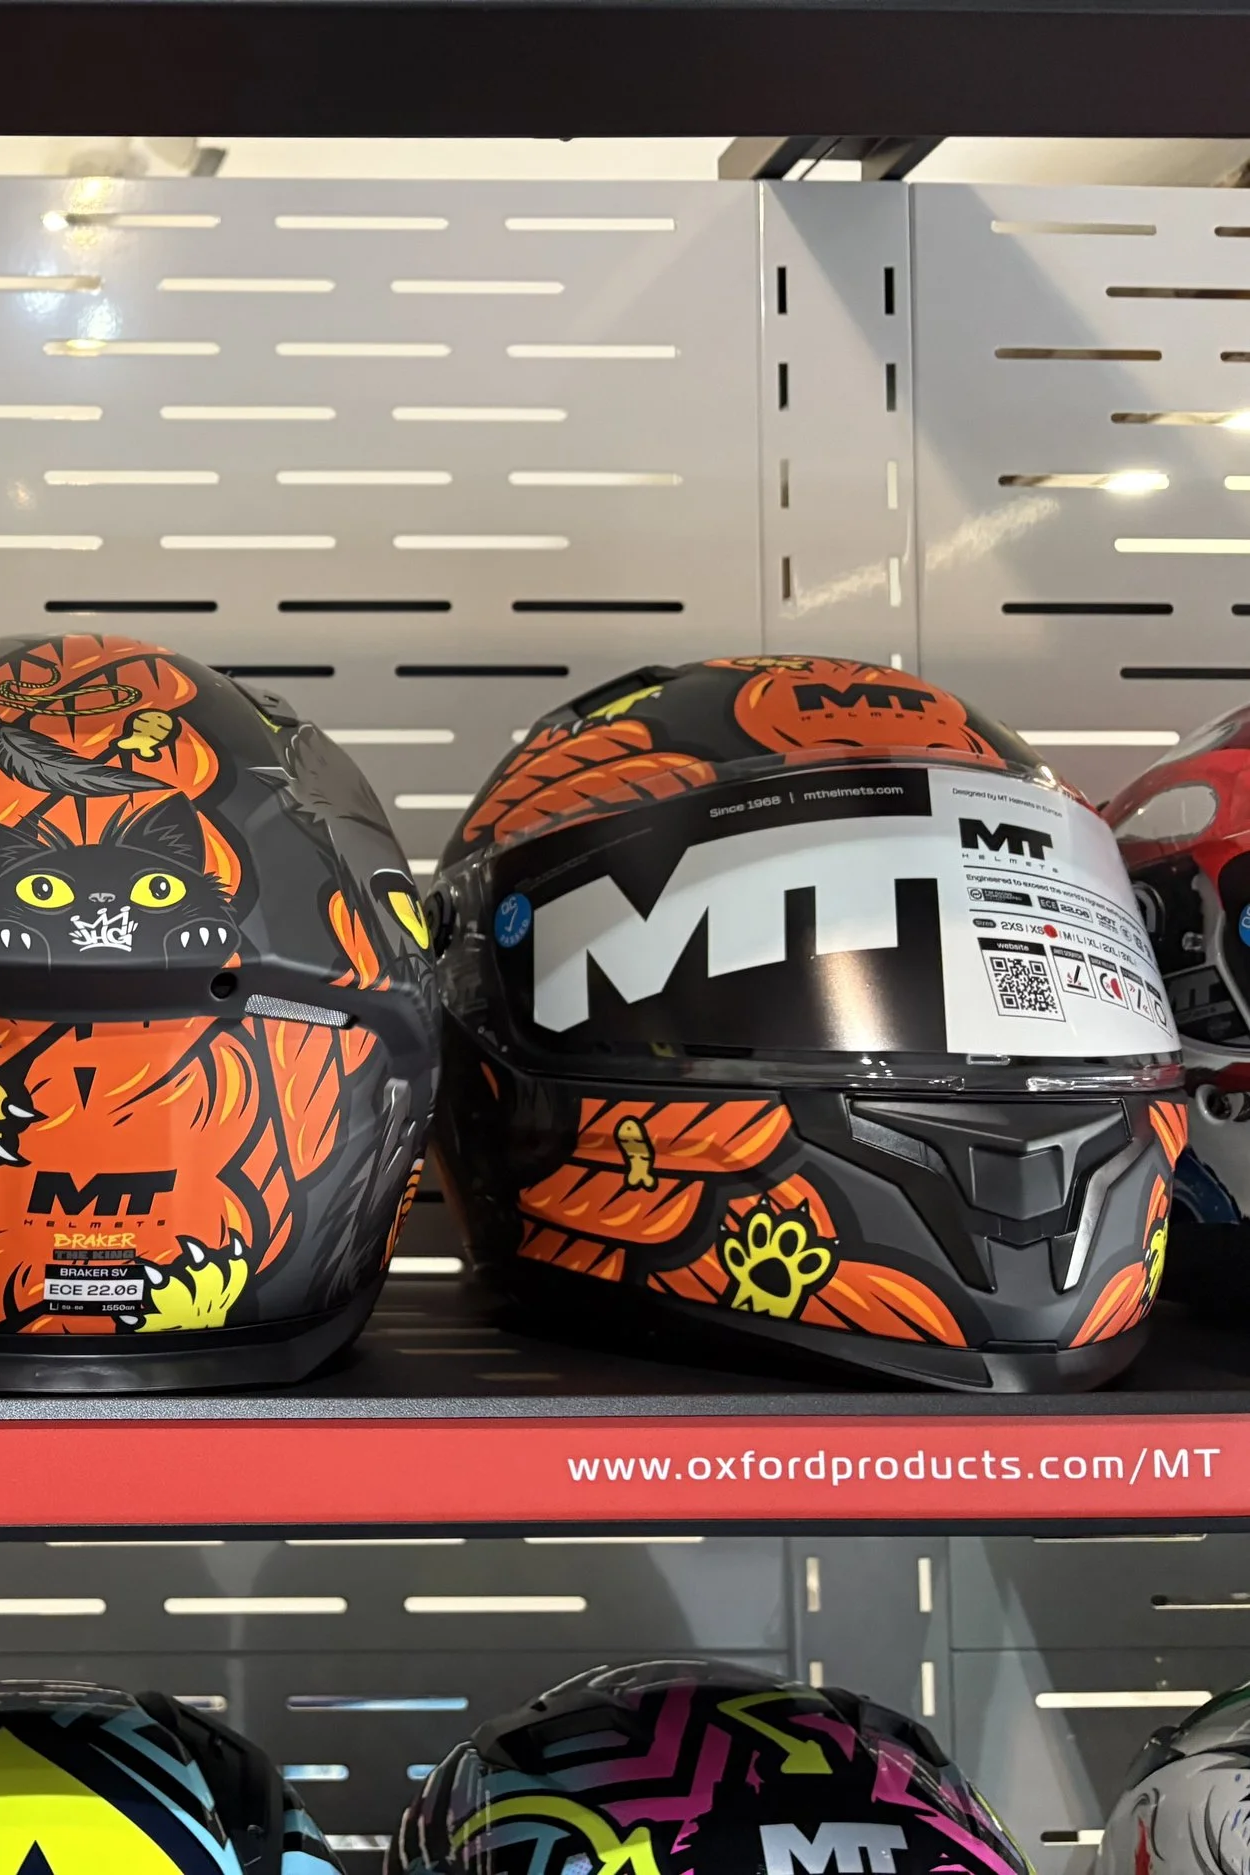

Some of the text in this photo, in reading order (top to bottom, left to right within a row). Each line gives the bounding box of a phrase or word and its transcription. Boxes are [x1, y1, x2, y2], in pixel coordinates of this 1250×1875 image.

[792, 683, 937, 712] MT
[709, 804, 745, 818] Since
[747, 795, 782, 810] 1968
[803, 784, 904, 801] mthelmets.com
[997, 794, 1008, 803] MT
[958, 817, 1054, 861] MT
[962, 852, 1059, 874] HELMETS
[966, 874, 1012, 885] Engineered
[1040, 899, 1058, 911] ECE
[534, 815, 938, 1033] MT
[1001, 921, 1024, 932] 2XS
[996, 942, 1030, 951] website
[27, 1169, 178, 1217] MT
[24, 1219, 166, 1229] HELMETS
[53, 1232, 137, 1249] BRAKER
[54, 1249, 135, 1260] THE KING
[59, 1267, 128, 1277] BRAKER SV
[49, 1284, 138, 1296] ECE 22.06
[567, 1447, 1222, 1486] www.oxfordproducts.com/MT
[759, 1821, 909, 1875] MT
